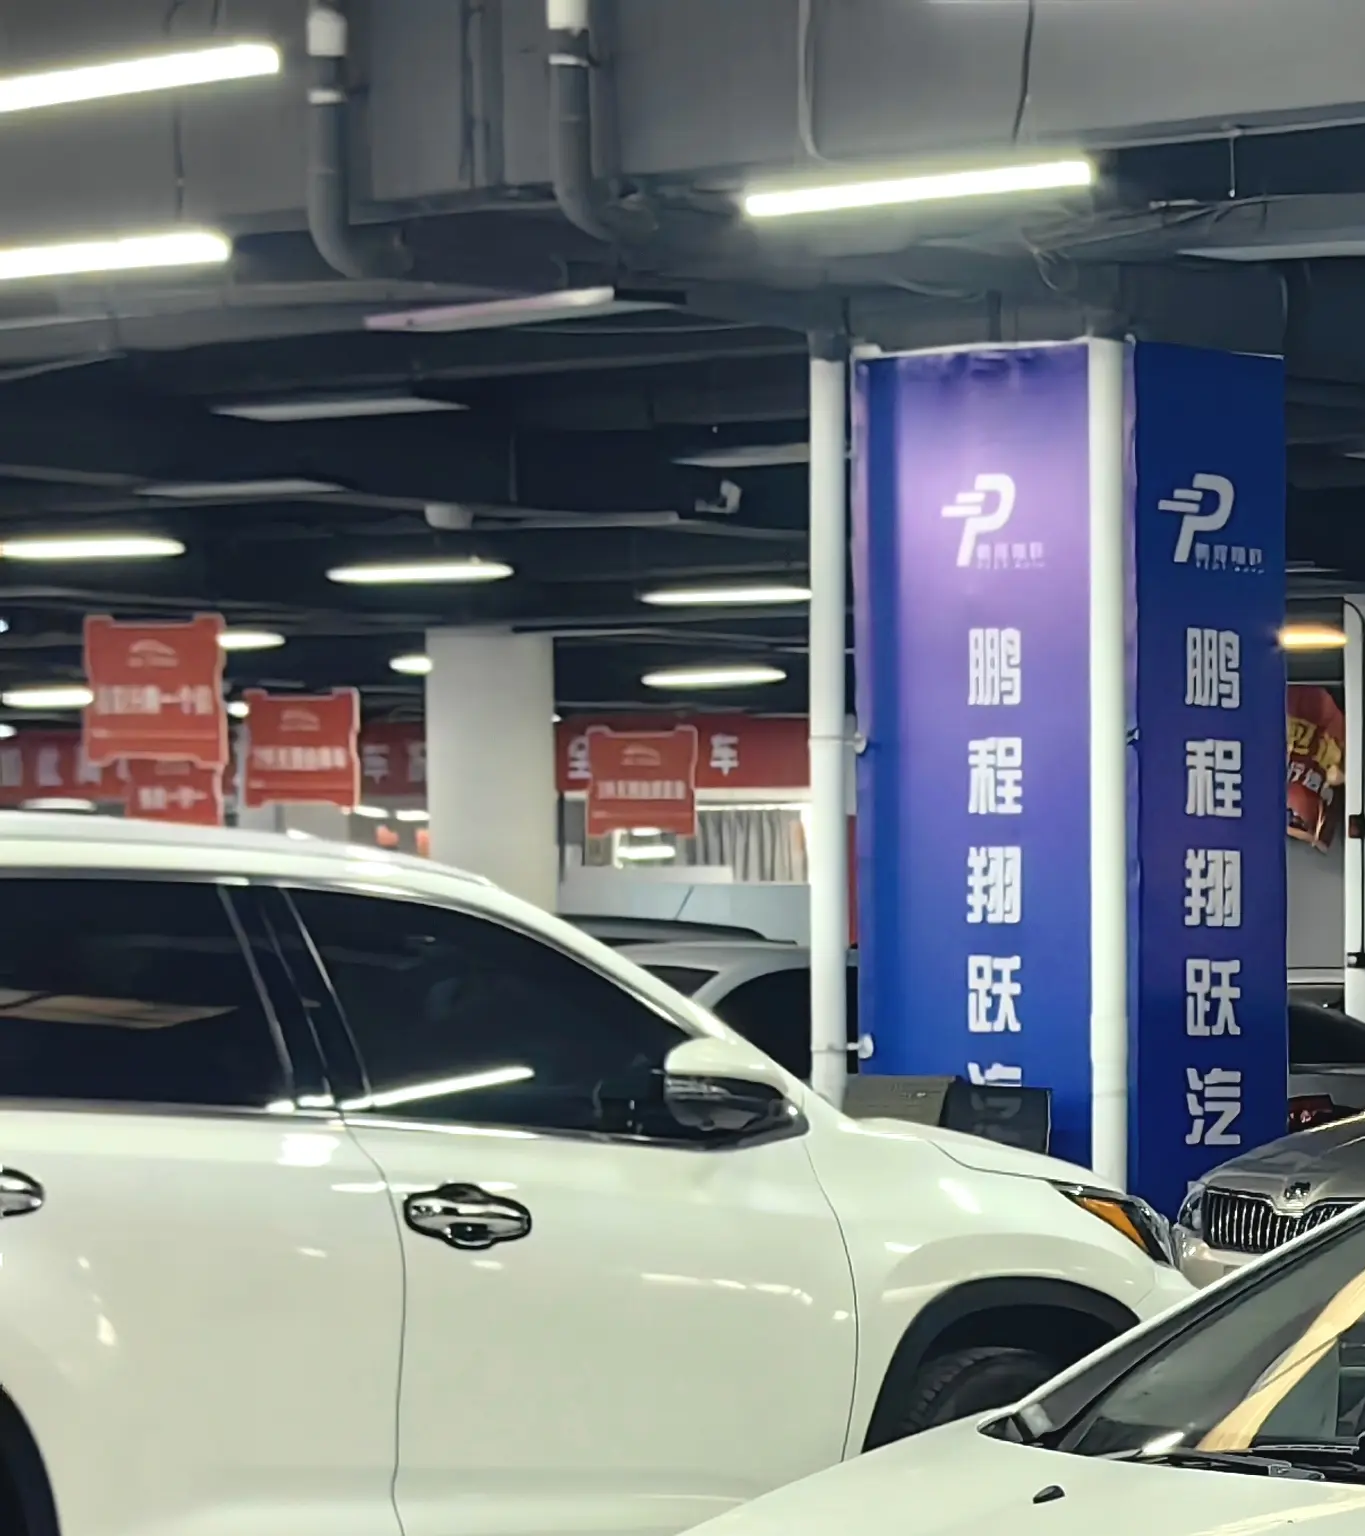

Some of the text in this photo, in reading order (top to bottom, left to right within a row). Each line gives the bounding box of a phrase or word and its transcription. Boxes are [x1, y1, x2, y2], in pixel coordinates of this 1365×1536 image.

[966, 626, 1023, 1087] 鹏程翔跃
[1183, 626, 1243, 1194] 鹏程翔跃汽
